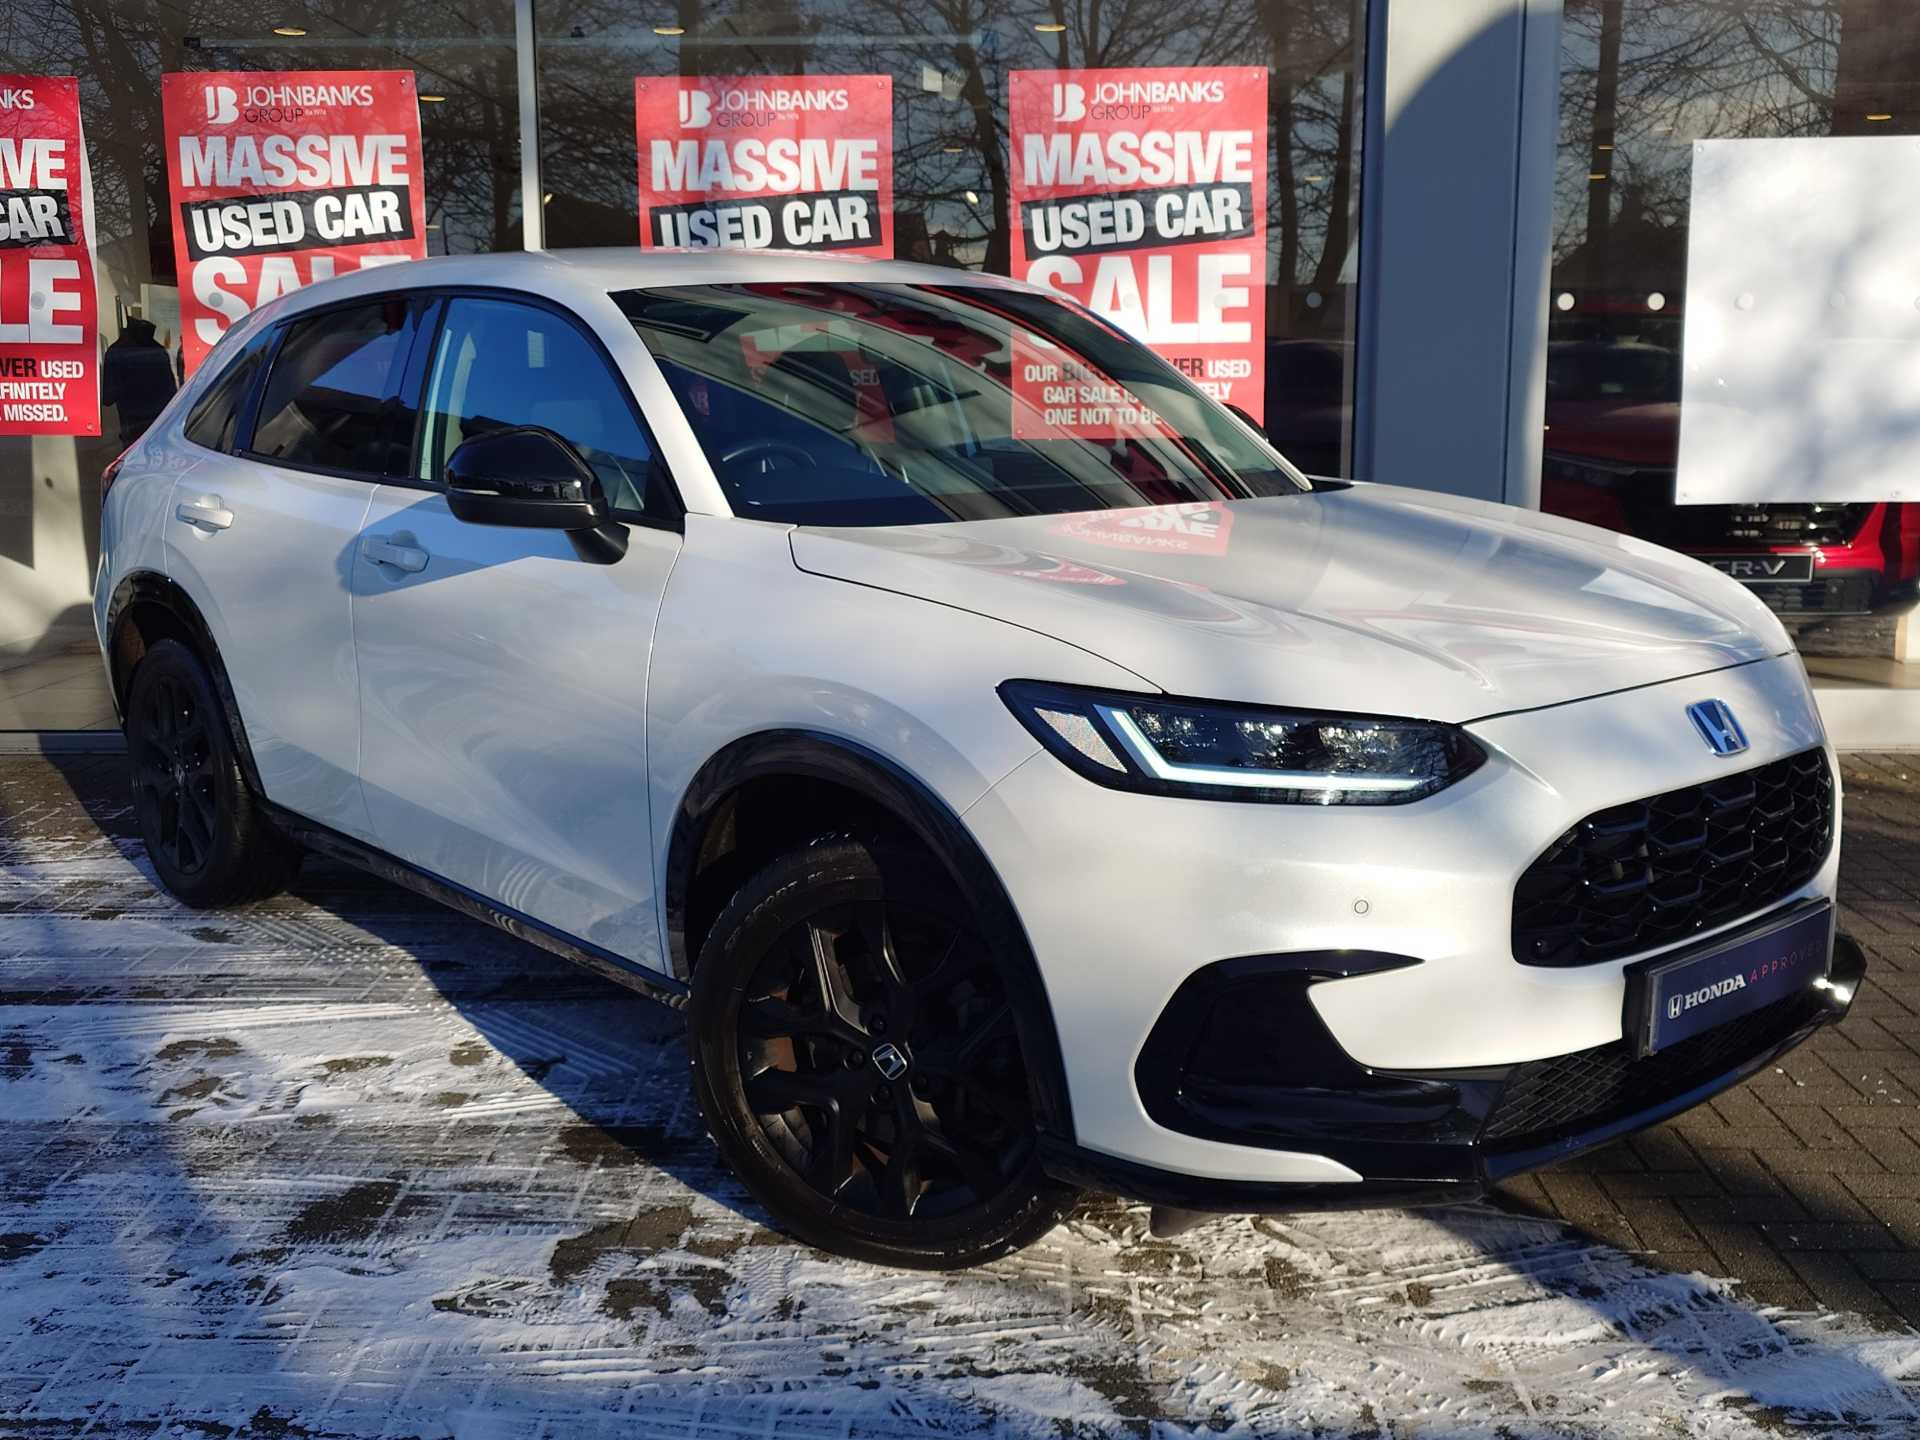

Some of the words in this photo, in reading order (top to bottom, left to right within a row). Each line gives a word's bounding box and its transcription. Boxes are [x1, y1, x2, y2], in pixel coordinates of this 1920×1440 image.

[243, 85, 374, 107] JOHNBANKS
[716, 90, 848, 111] JOHNBANKS
[1091, 80, 1224, 104] JOHNBANKS
[244, 108, 304, 123] GROUP
[716, 112, 777, 128] GROUP
[1091, 104, 1152, 120] GROUP
[179, 134, 409, 187] MASSIVE
[651, 138, 879, 192] MASSIVE
[1023, 130, 1253, 186] MASSIVE
[191, 200, 305, 252] USED
[313, 190, 403, 240] CAR
[660, 204, 773, 249] USED
[782, 196, 872, 246] CAR
[1031, 198, 1145, 251] USED
[1155, 188, 1243, 238] CAR
[41, 360, 83, 378] USED
[1024, 364, 1058, 382] OUR
[1208, 360, 1251, 378] USED
[1043, 386, 1076, 404] CAR
[1080, 386, 1121, 403] SALE
[4, 404, 68, 422] MISSED.
[1044, 408, 1078, 425] ONE
[1081, 408, 1113, 425] NOT
[1115, 407, 1137, 425] TO
[1683, 974, 1747, 1010] HONDA
